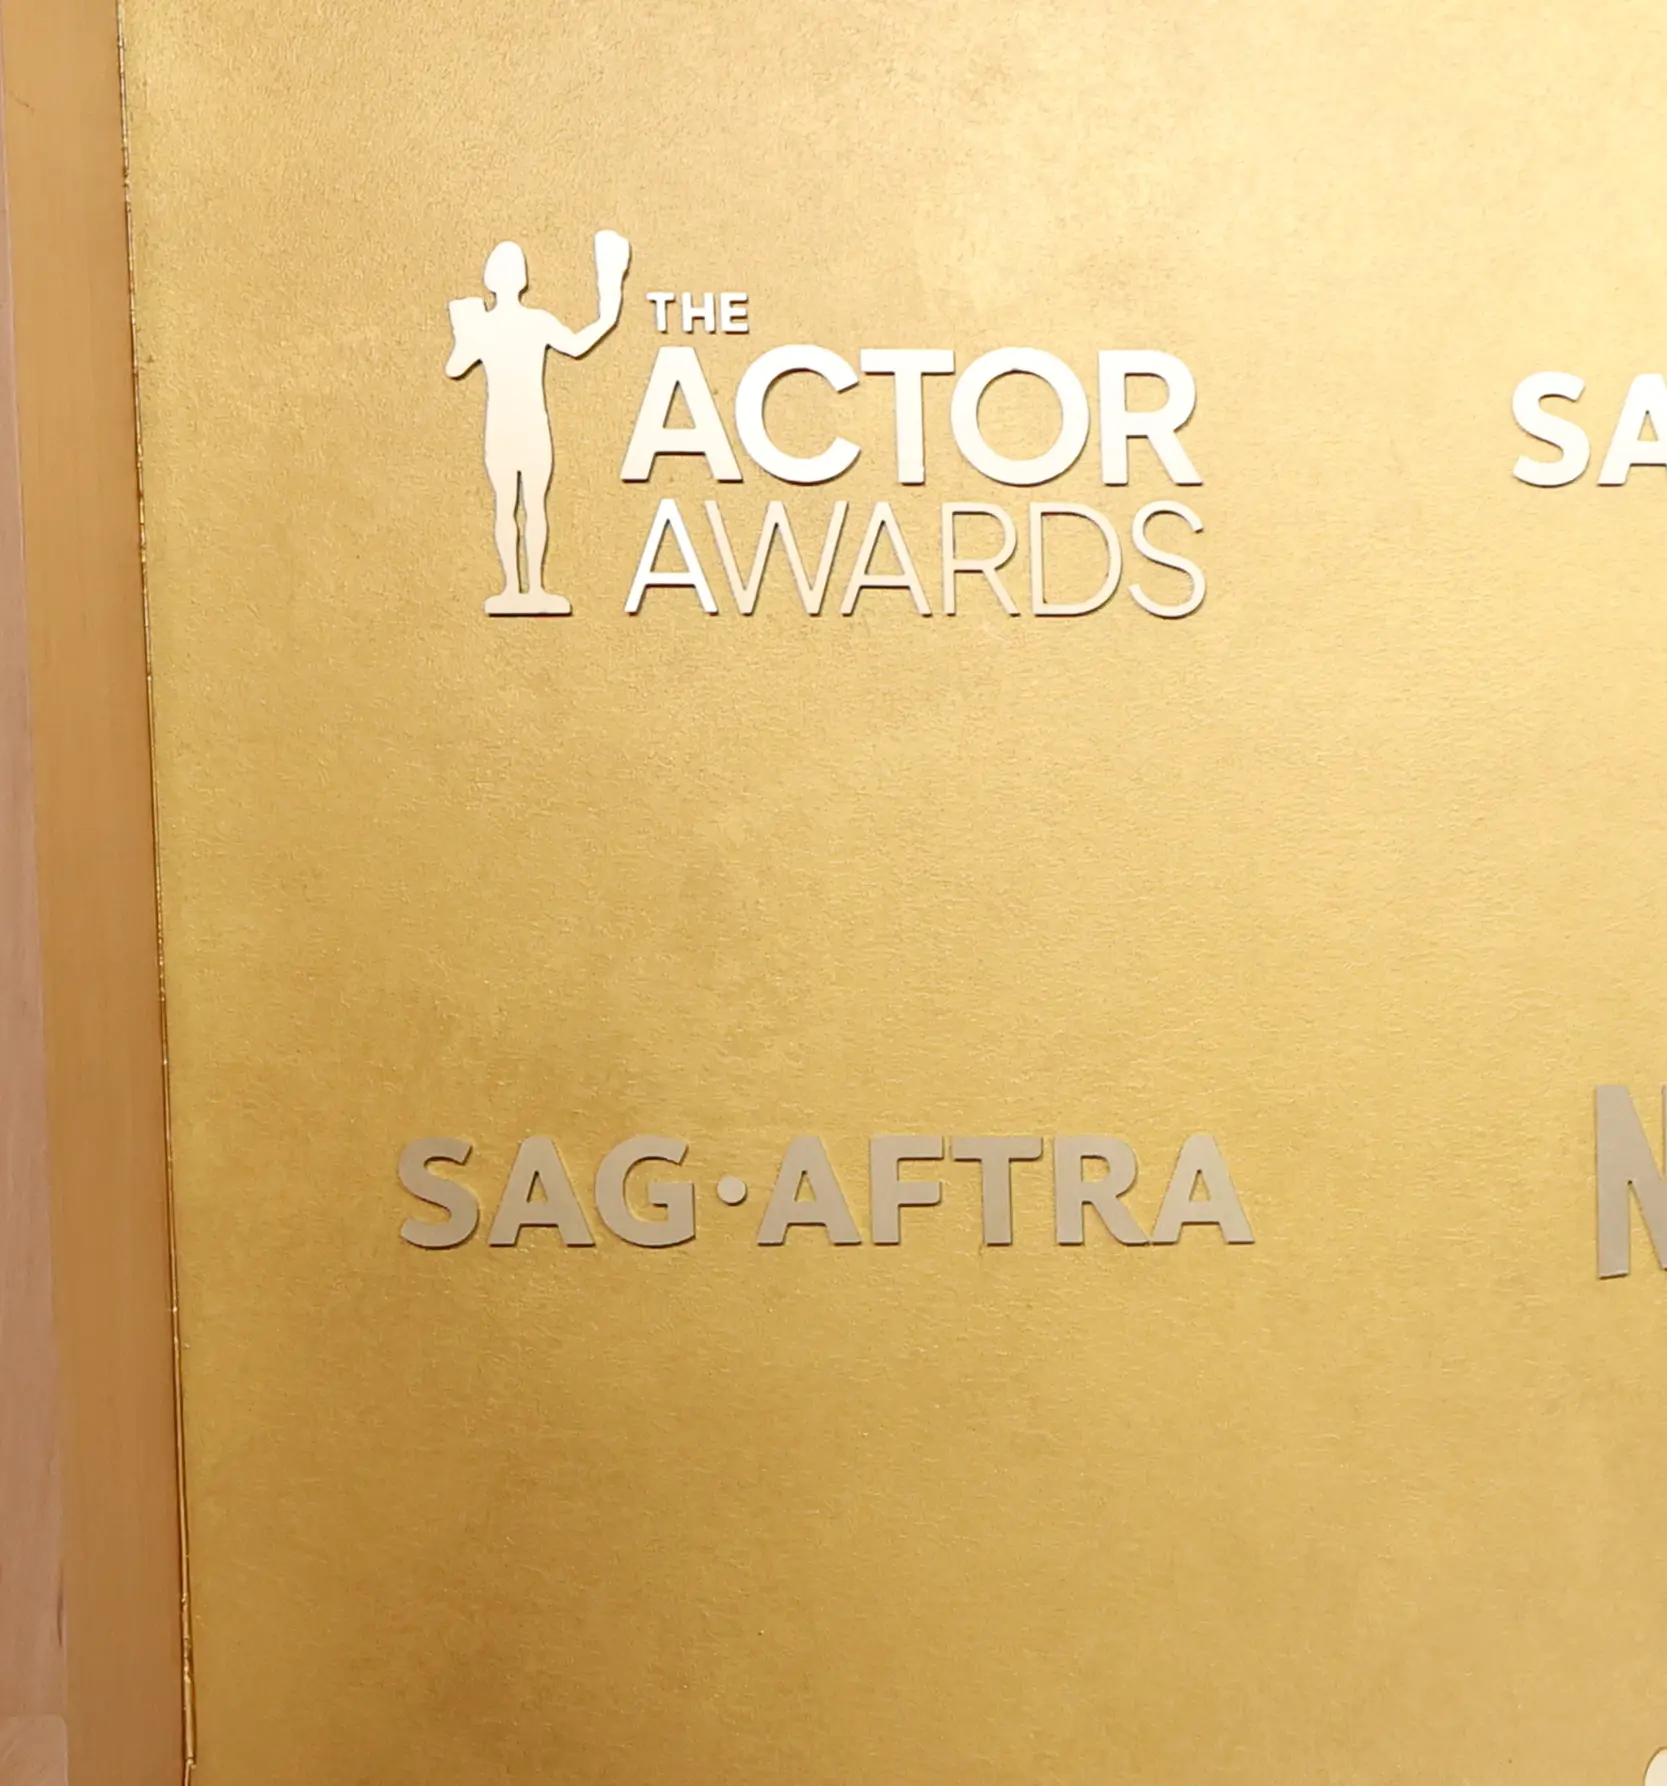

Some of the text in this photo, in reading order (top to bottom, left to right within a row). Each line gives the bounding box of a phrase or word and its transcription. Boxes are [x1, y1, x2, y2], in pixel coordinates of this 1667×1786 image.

[647, 291, 750, 334] THE
[619, 344, 1203, 486] ACTOR
[624, 498, 1206, 619] AWARDS
